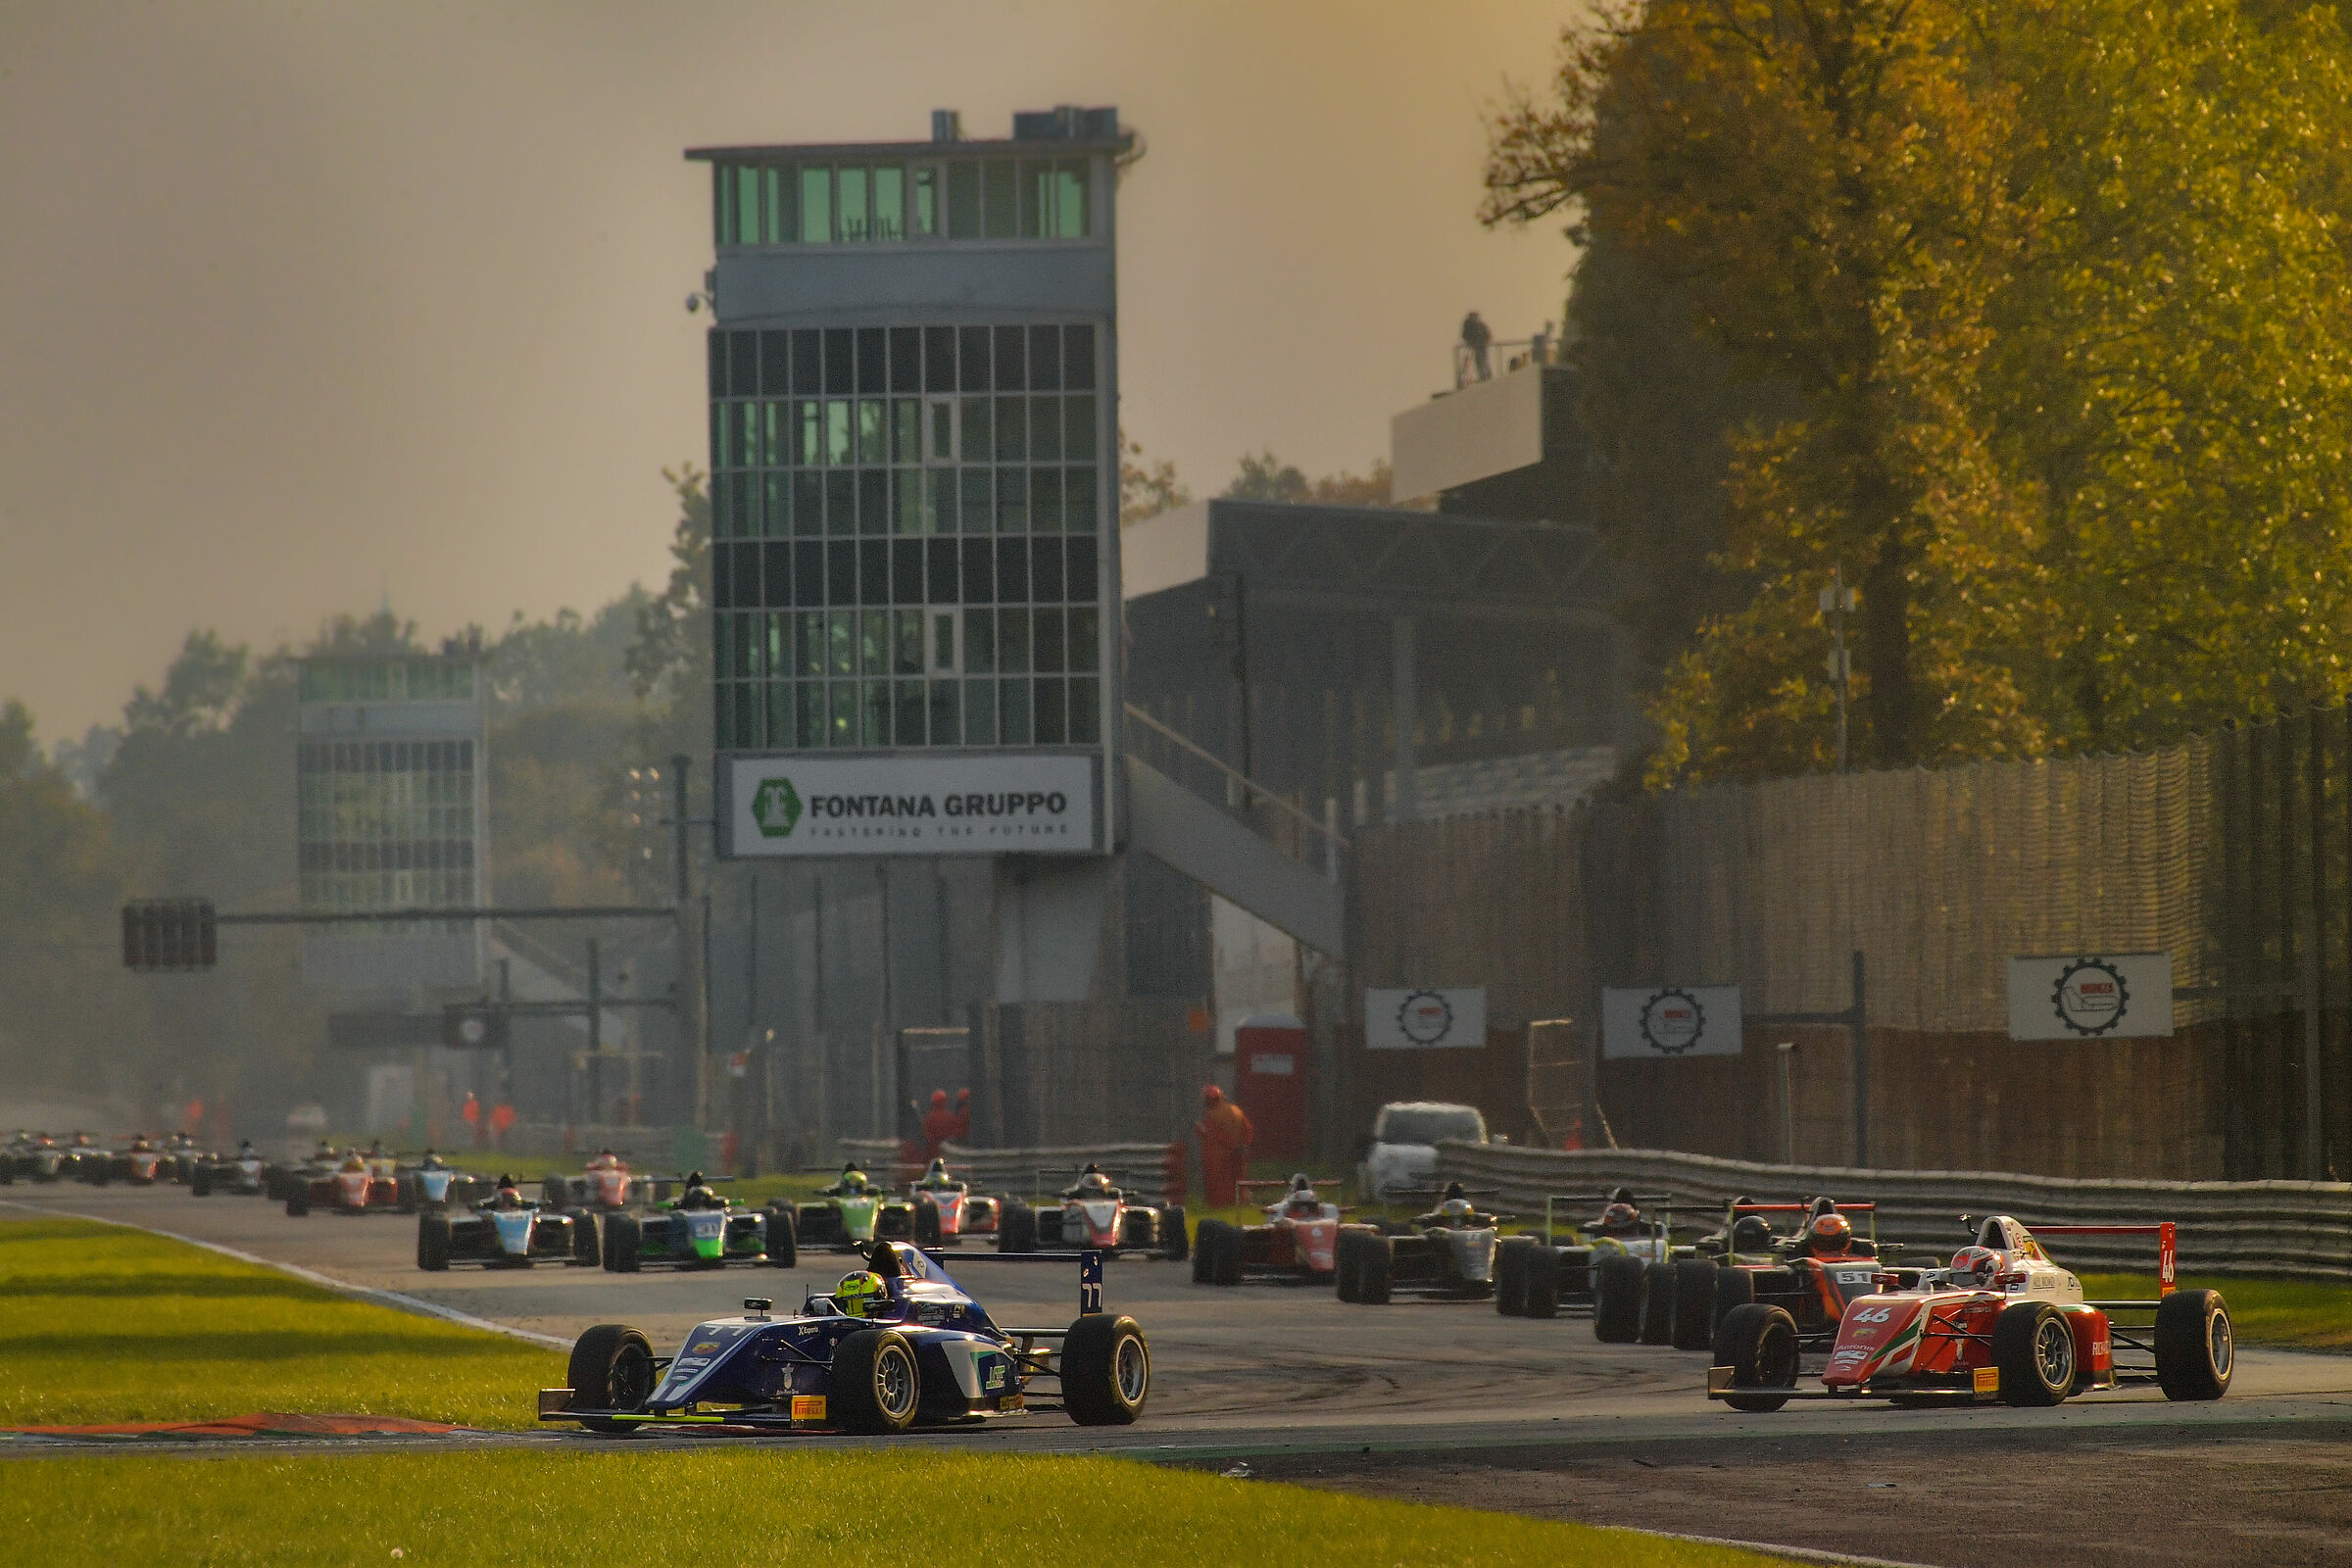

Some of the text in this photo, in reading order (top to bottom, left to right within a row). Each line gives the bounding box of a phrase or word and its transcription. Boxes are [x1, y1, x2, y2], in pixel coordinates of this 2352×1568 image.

[809, 792, 1068, 818] FONTANA GRUPPO
[937, 824, 973, 837] THE
[989, 823, 1068, 837] FUTURE
[2162, 1250, 2175, 1284] 46
[1842, 1272, 1868, 1283] 51
[1082, 1283, 1102, 1308] 77
[1853, 1306, 1892, 1323] 46
[705, 1324, 747, 1337] 77
[794, 1400, 823, 1415] PIRELLI
